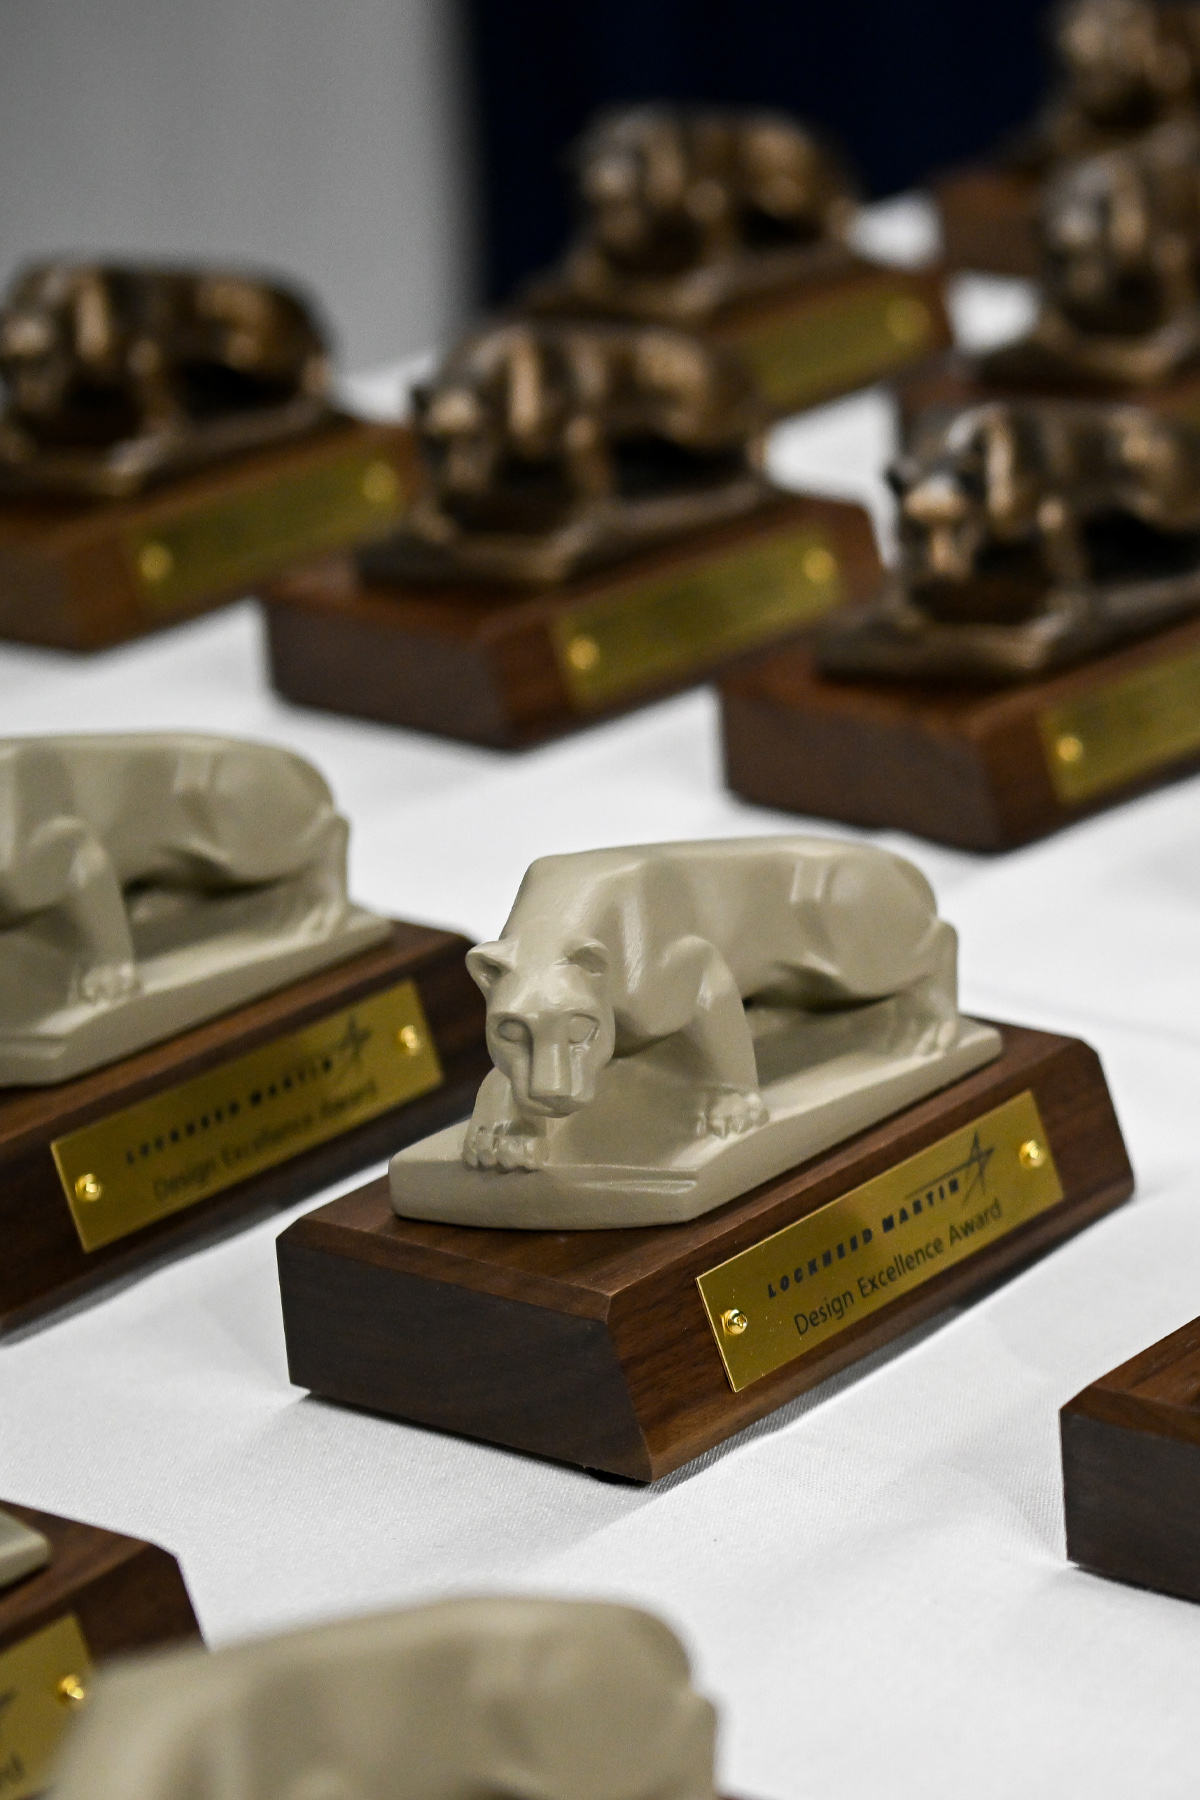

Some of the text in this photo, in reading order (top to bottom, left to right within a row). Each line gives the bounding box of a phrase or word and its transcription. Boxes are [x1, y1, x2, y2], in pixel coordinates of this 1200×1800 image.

[767, 1178, 960, 1299] LOCKHEED MARTIN
[793, 1197, 1002, 1336] Design Excellence Award
